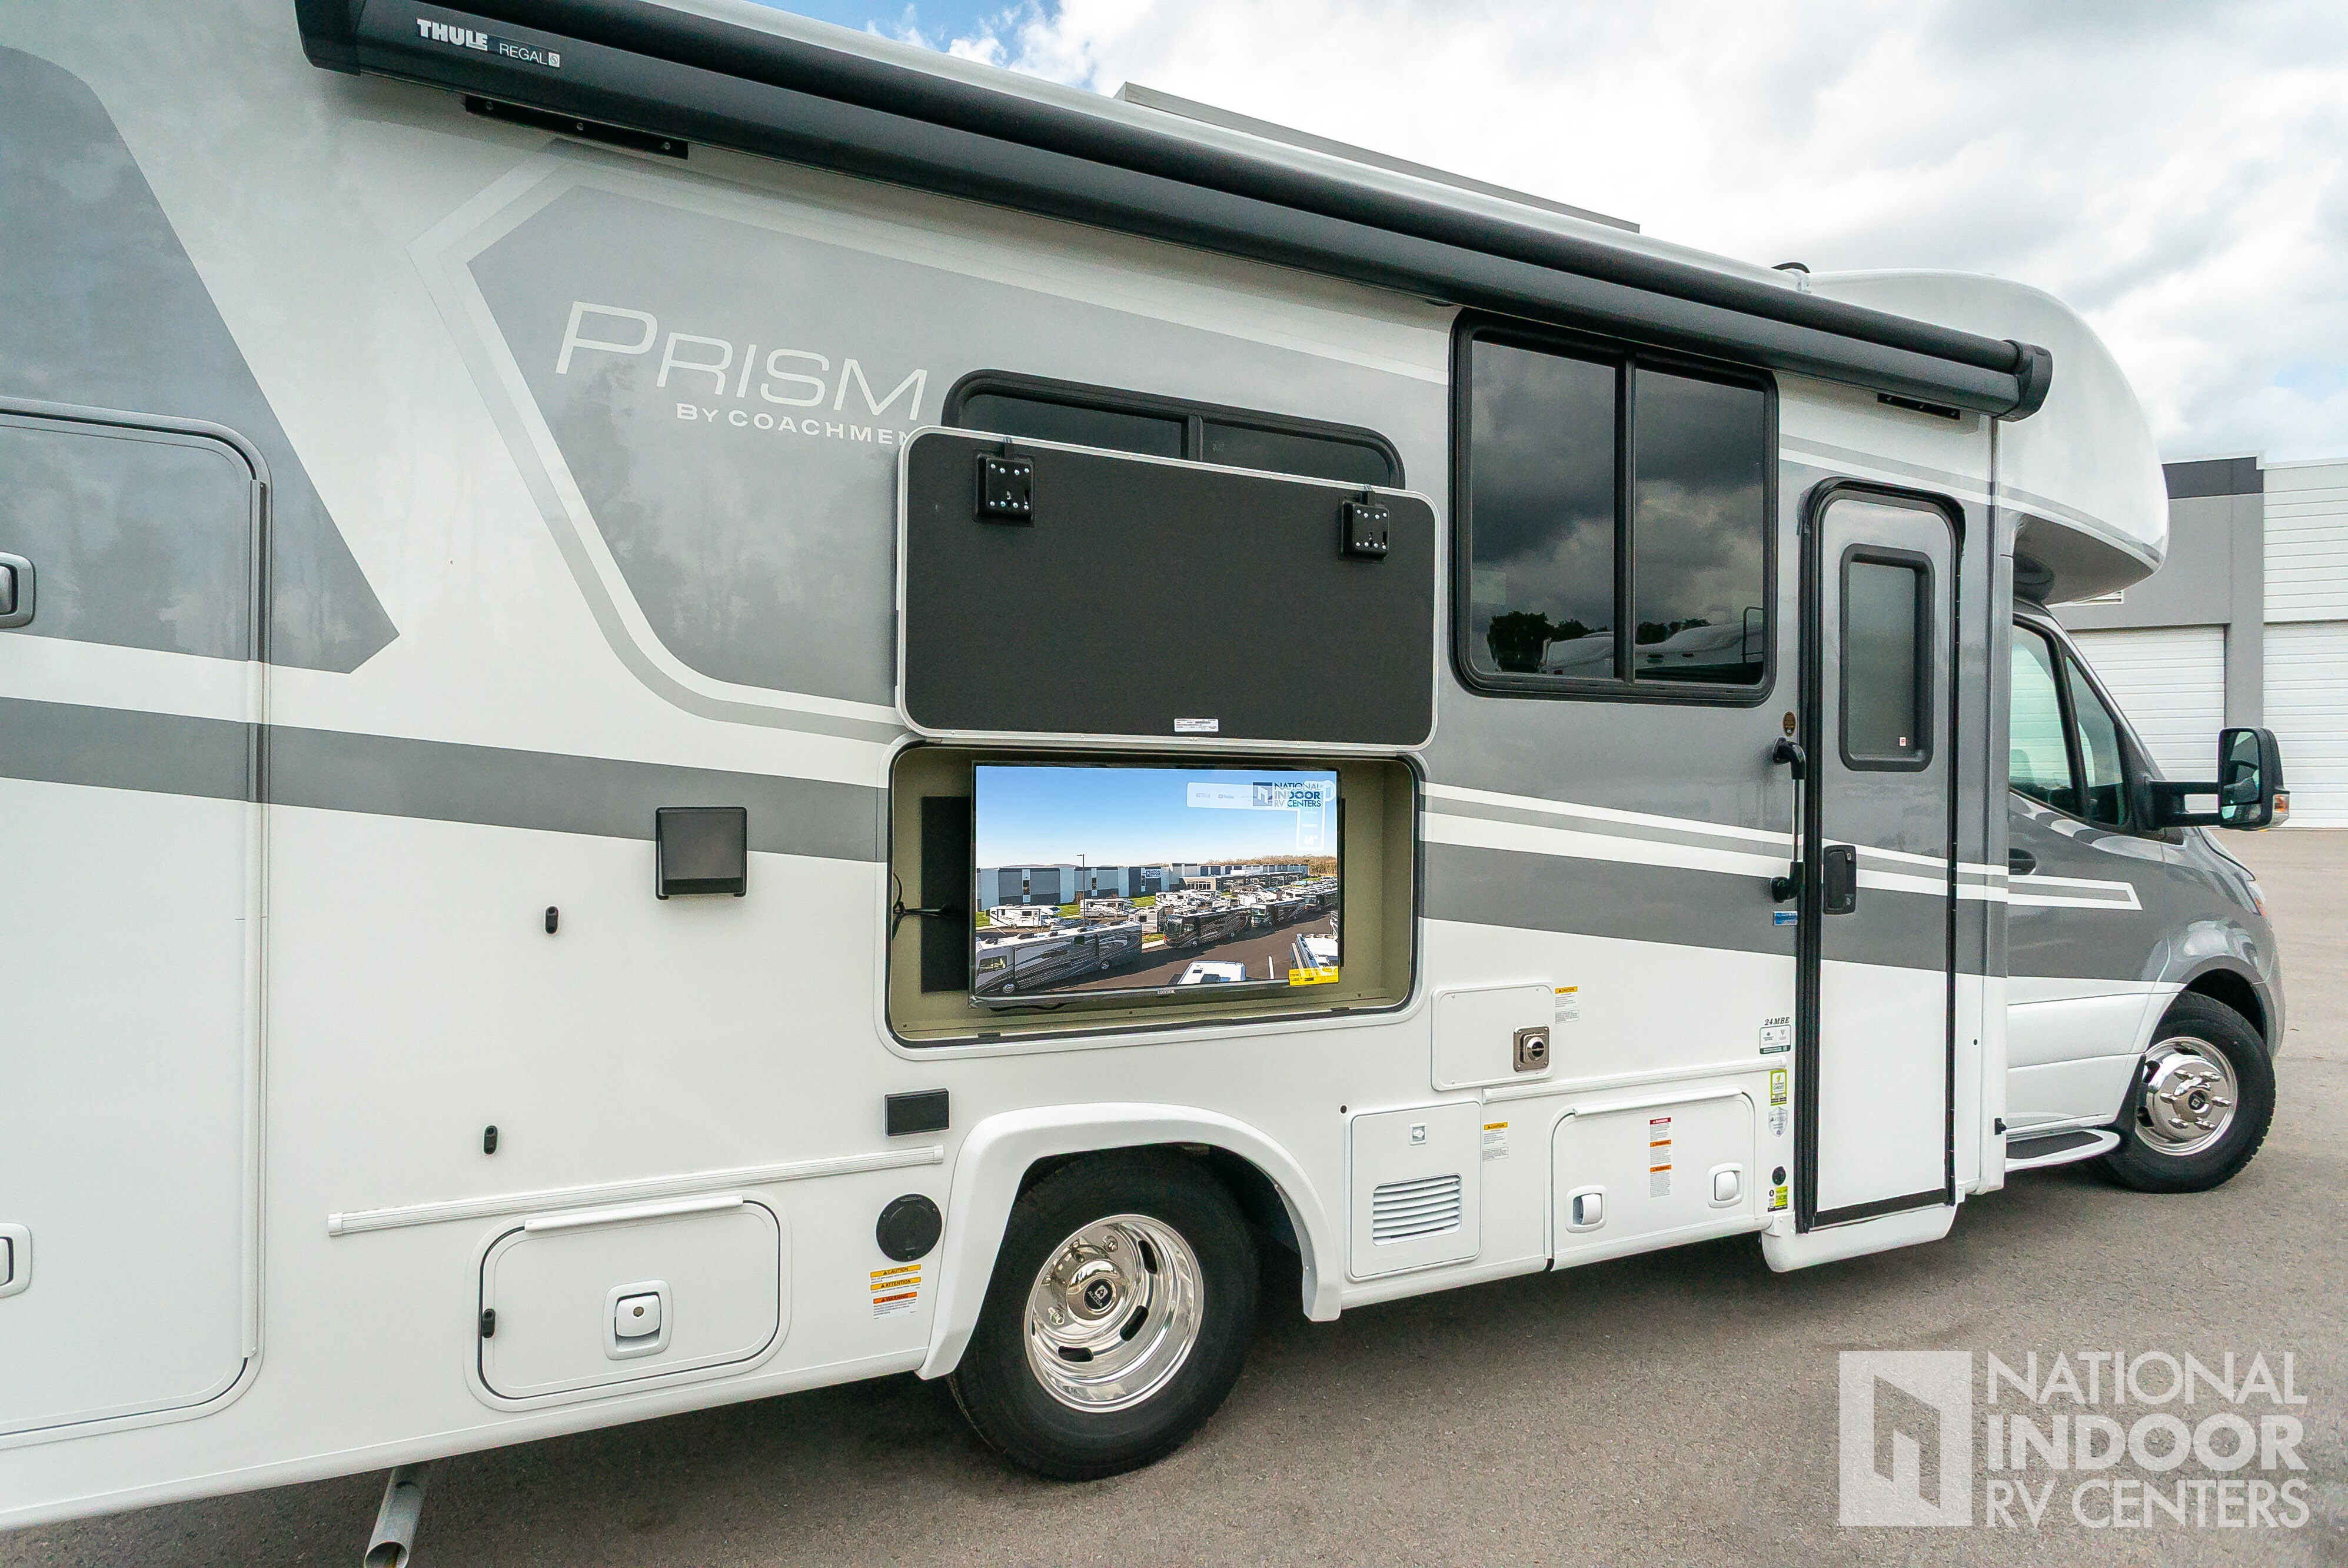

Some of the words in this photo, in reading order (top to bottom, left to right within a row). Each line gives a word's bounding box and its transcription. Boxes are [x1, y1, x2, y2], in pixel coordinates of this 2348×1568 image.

[417, 18, 488, 51] THULE
[500, 43, 548, 65] REGAL
[556, 301, 928, 421] PRISM
[676, 403, 719, 422] BY
[1274, 782, 1322, 791] NATIONAL
[1274, 791, 1322, 800] INDOOR
[885, 1279, 911, 1287] ATTENTION
[1087, 1291, 1103, 1307] ALCOA
